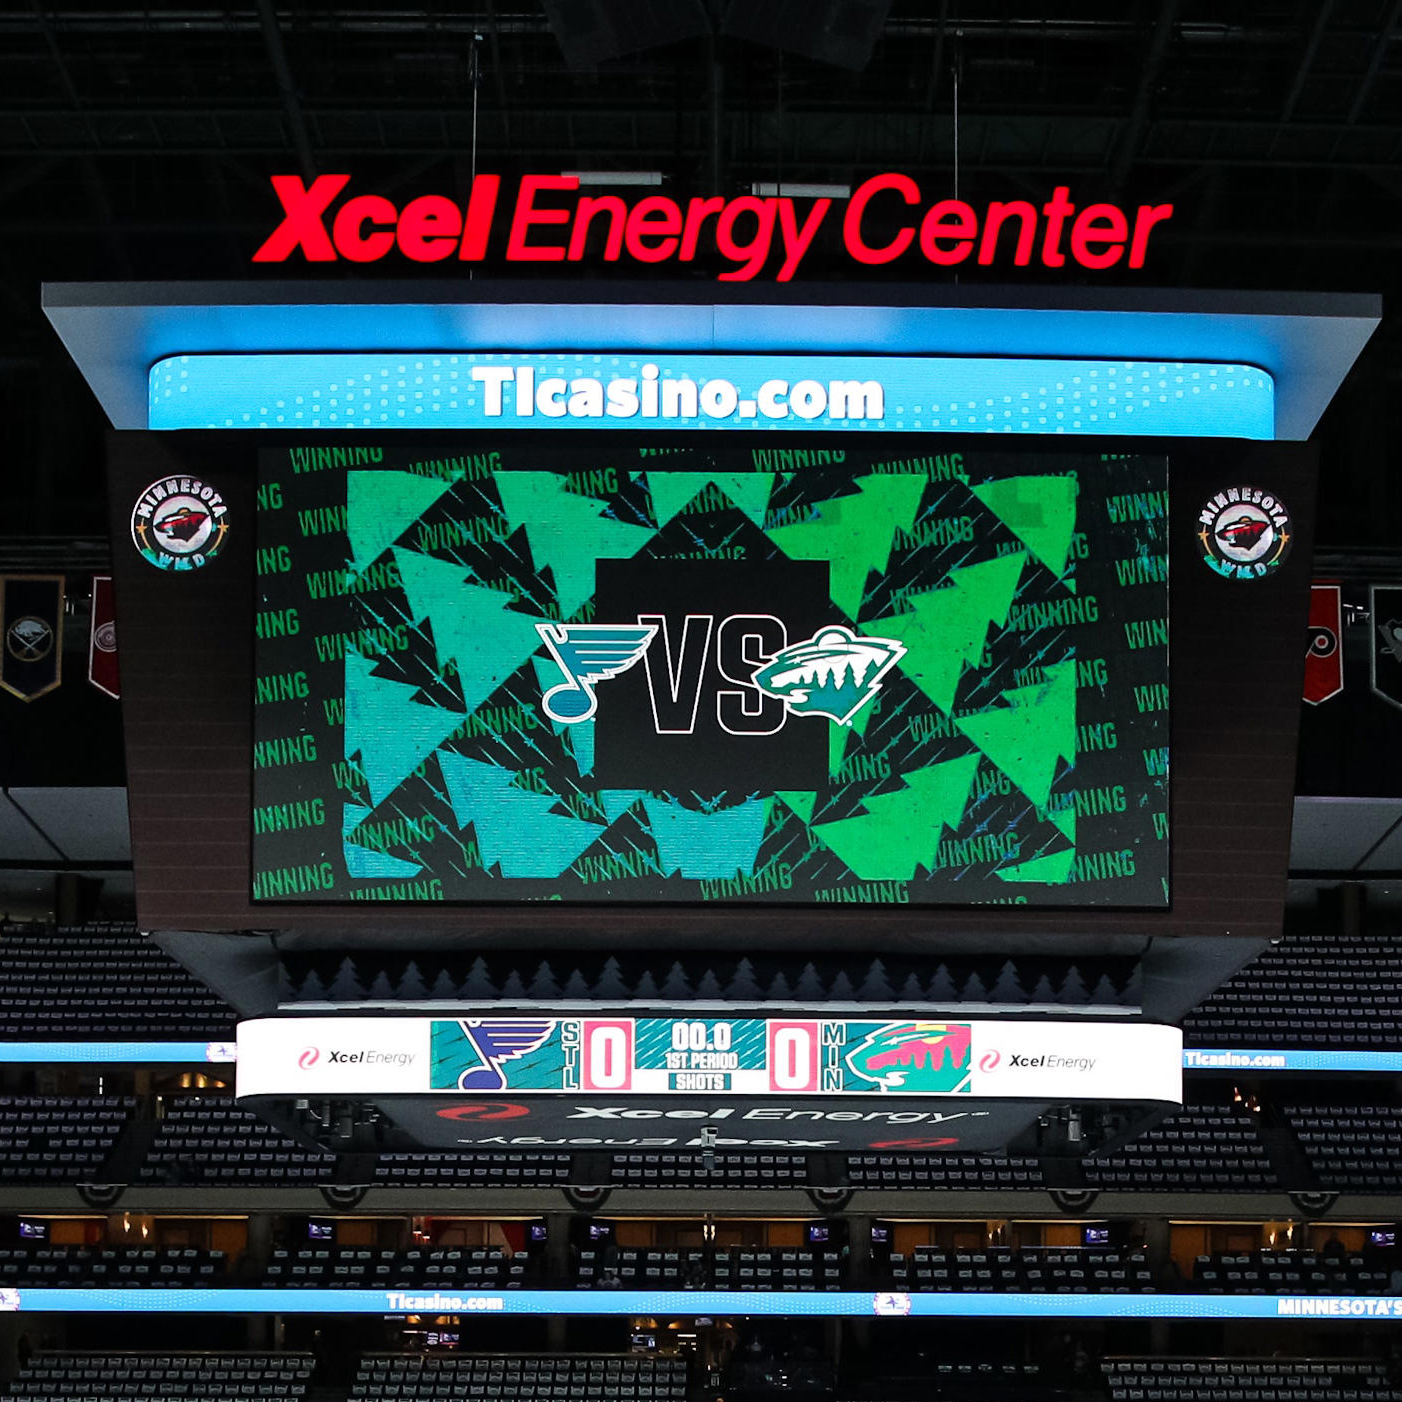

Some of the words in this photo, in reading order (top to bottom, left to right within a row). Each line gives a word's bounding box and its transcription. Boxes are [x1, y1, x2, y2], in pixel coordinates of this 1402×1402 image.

[252, 172, 503, 264] Xcel
[507, 174, 829, 282] Energy
[842, 172, 1172, 270] Center
[472, 362, 884, 420] TIcasino.com
[137, 479, 227, 518] MINNESOTA
[1199, 487, 1289, 528] MINNESOTA
[637, 613, 788, 736] VS
[561, 1022, 580, 1090] STL
[672, 1022, 731, 1050] 00.0
[328, 1051, 364, 1063] Xcel
[366, 1051, 416, 1066] Energy
[591, 1027, 626, 1088] 0
[665, 1053, 688, 1069] 1ST
[691, 1052, 738, 1069] PERIOD
[774, 1028, 809, 1089] 0
[822, 1023, 846, 1091] MIN
[1009, 1054, 1045, 1067] Xcel
[1047, 1055, 1096, 1071] Energy
[676, 1074, 724, 1090] SHOTS
[566, 1107, 735, 1119] Xcel
[742, 1108, 971, 1124] Energy
